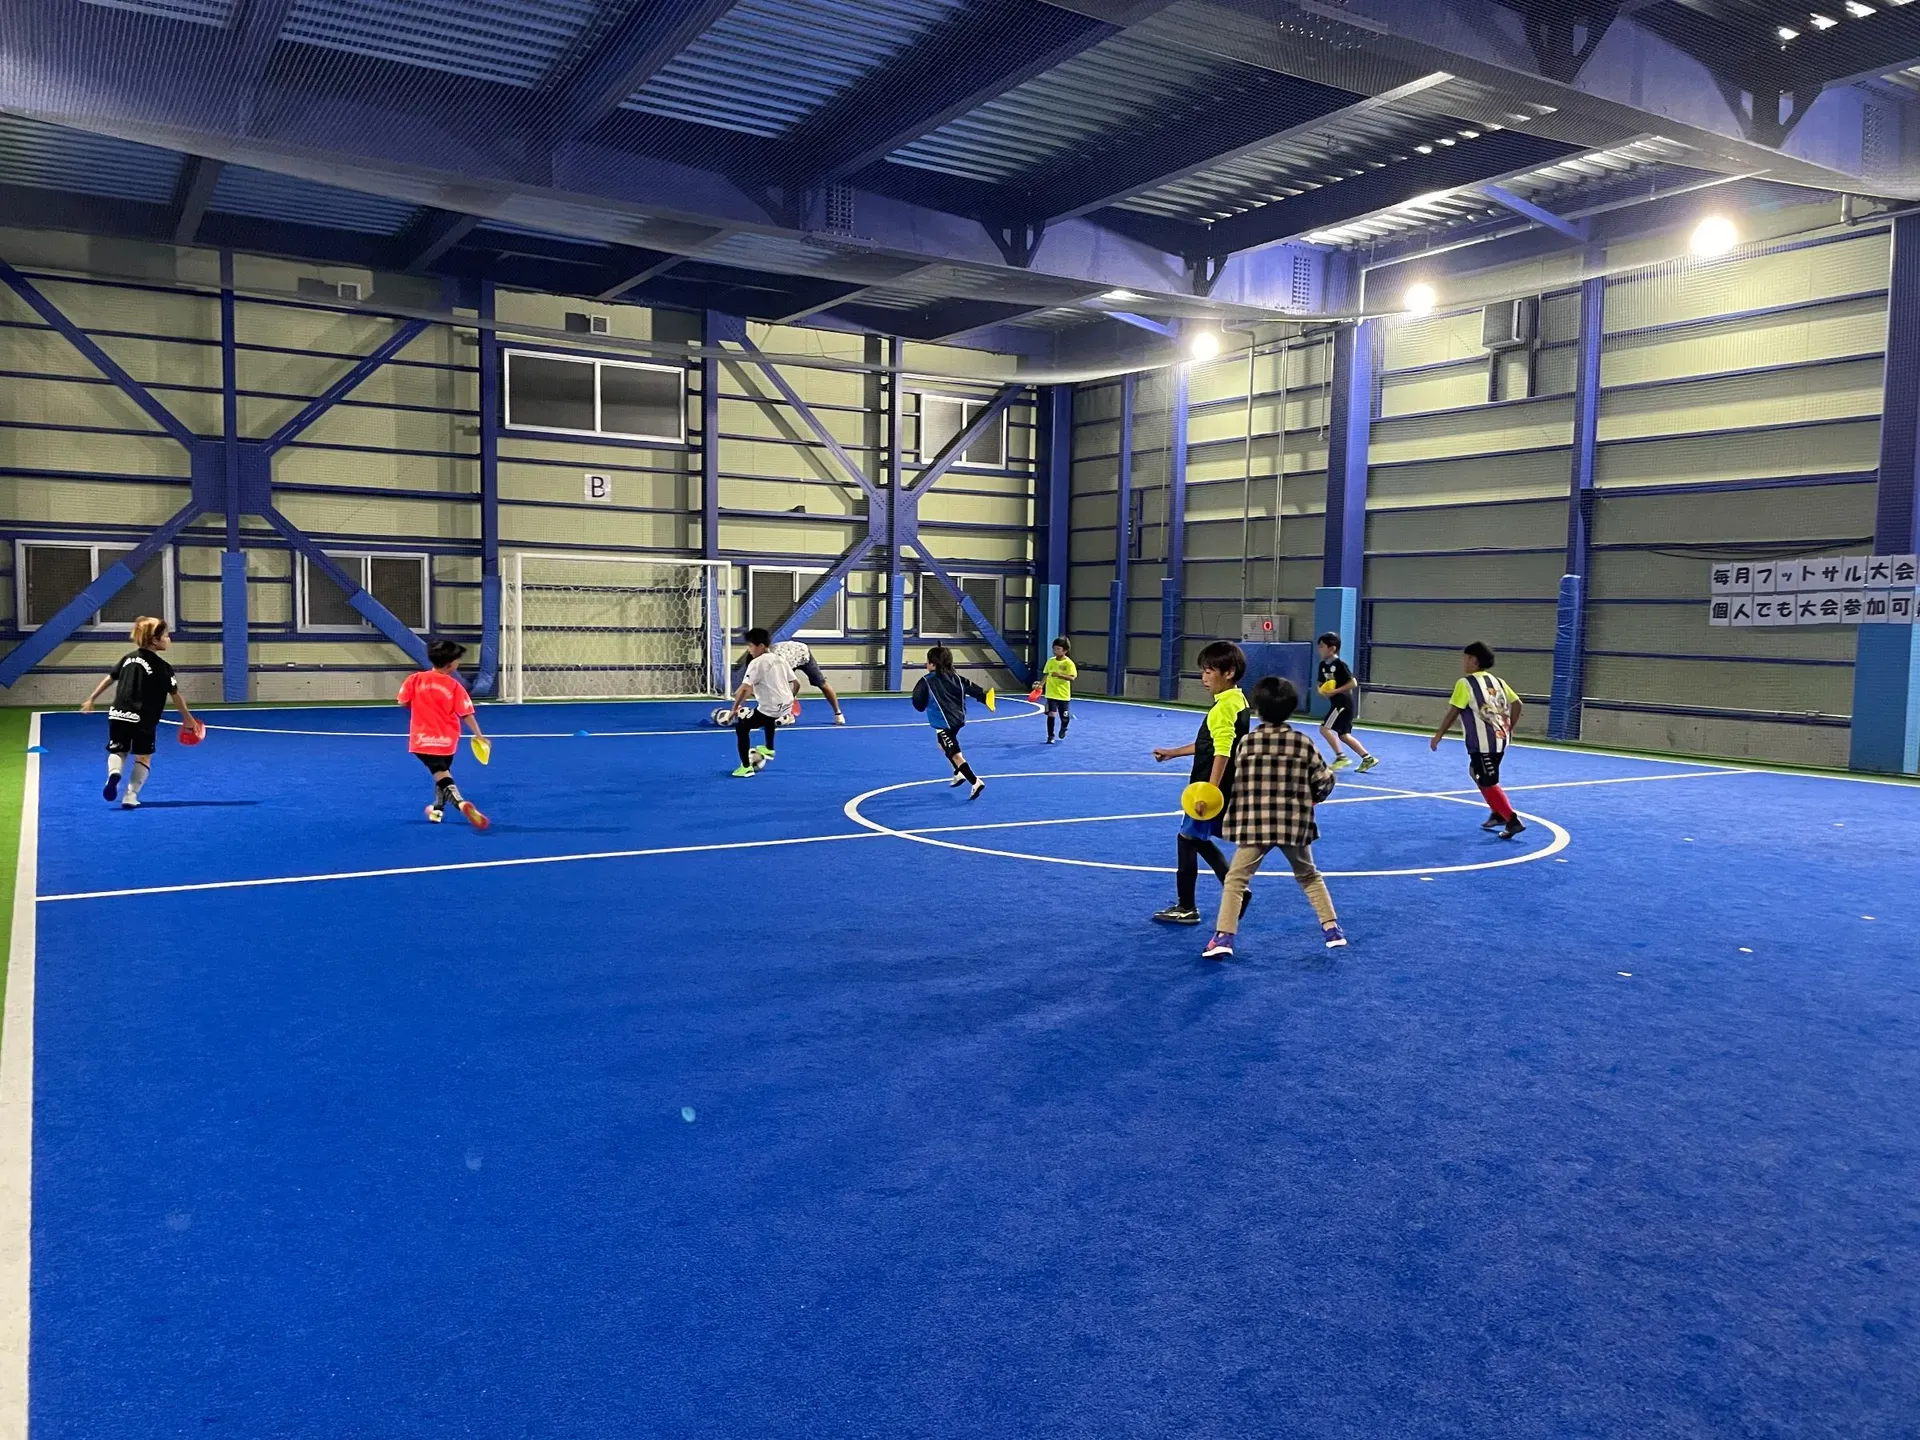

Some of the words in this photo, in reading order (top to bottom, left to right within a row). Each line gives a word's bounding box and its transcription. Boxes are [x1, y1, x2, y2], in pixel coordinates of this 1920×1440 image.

[591, 476, 605, 498] B
[1713, 562, 1915, 585] 毎月フットサル大会
